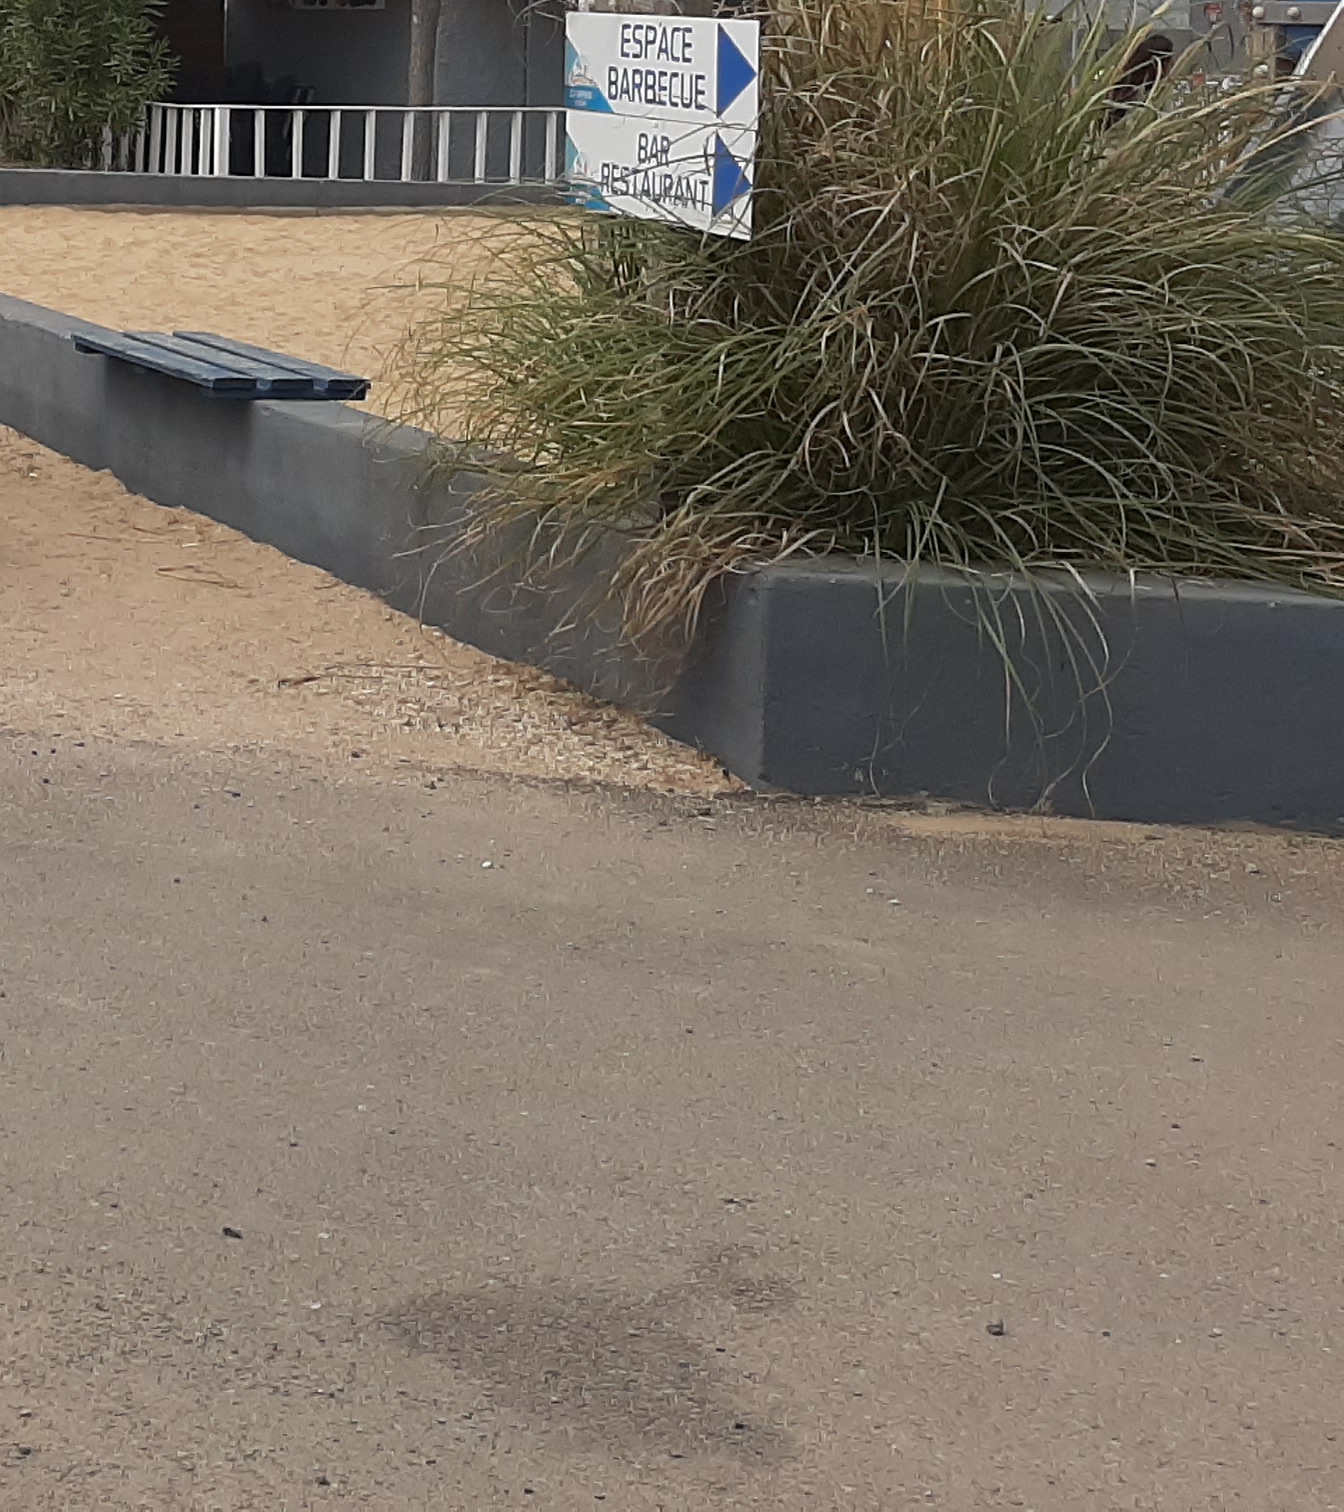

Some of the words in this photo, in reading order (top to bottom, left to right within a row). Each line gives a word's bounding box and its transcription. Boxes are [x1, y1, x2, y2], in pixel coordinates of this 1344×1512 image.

[620, 24, 693, 63] ESPACE
[608, 66, 706, 111] BARBECUE
[638, 133, 670, 167] BAR
[601, 163, 709, 211] RESTAURANT
